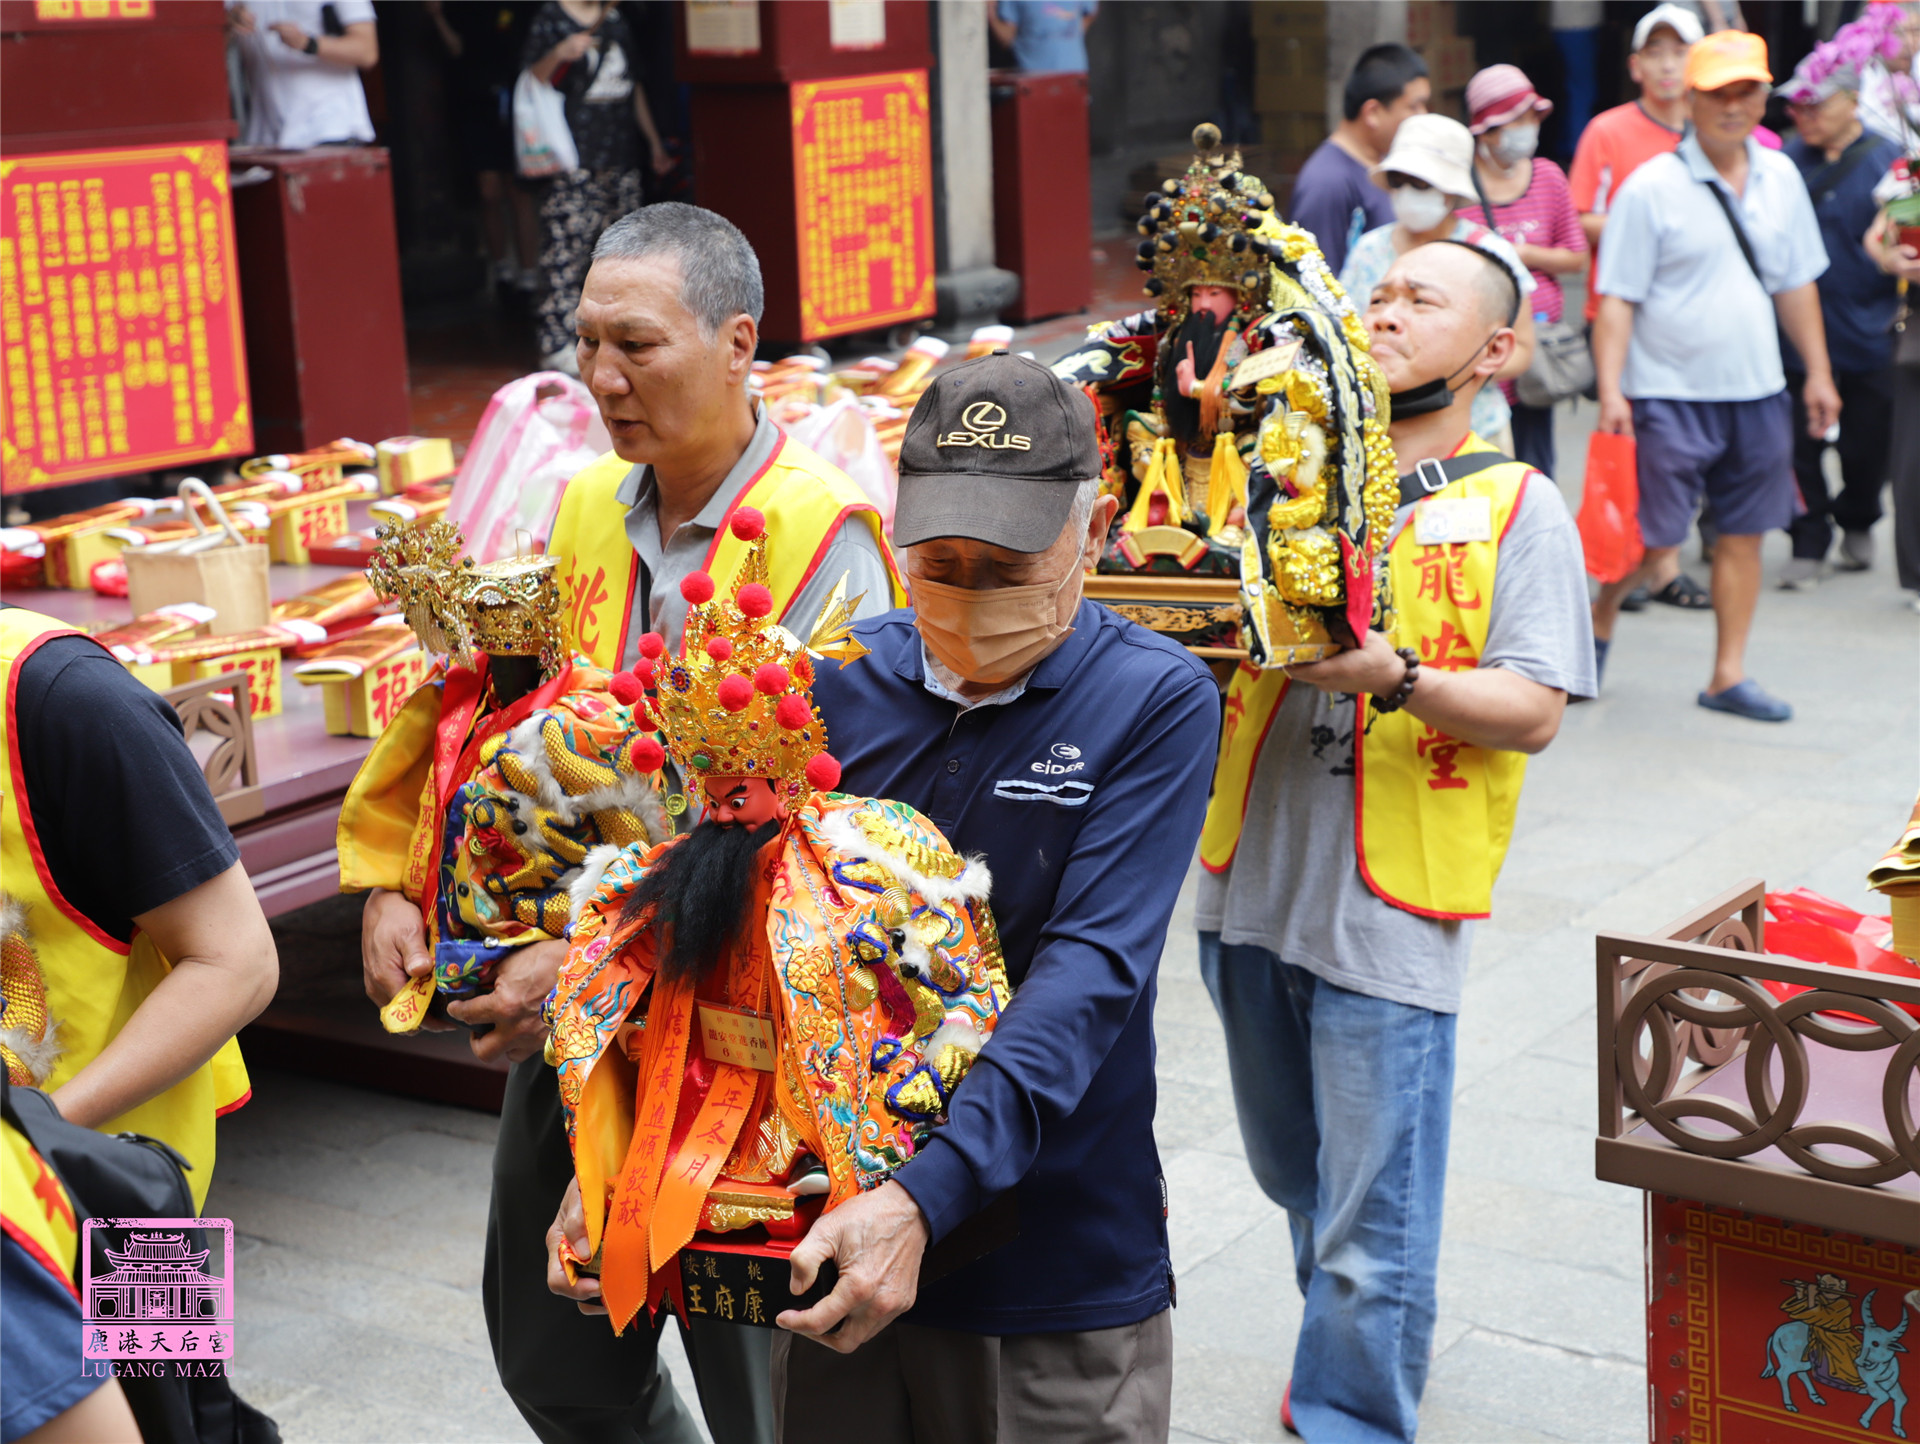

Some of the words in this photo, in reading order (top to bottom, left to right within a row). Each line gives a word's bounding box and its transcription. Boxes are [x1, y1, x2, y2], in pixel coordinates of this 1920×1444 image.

[936, 431, 1031, 452] LEXUS
[564, 552, 609, 655] 桃
[371, 661, 411, 731] 福
